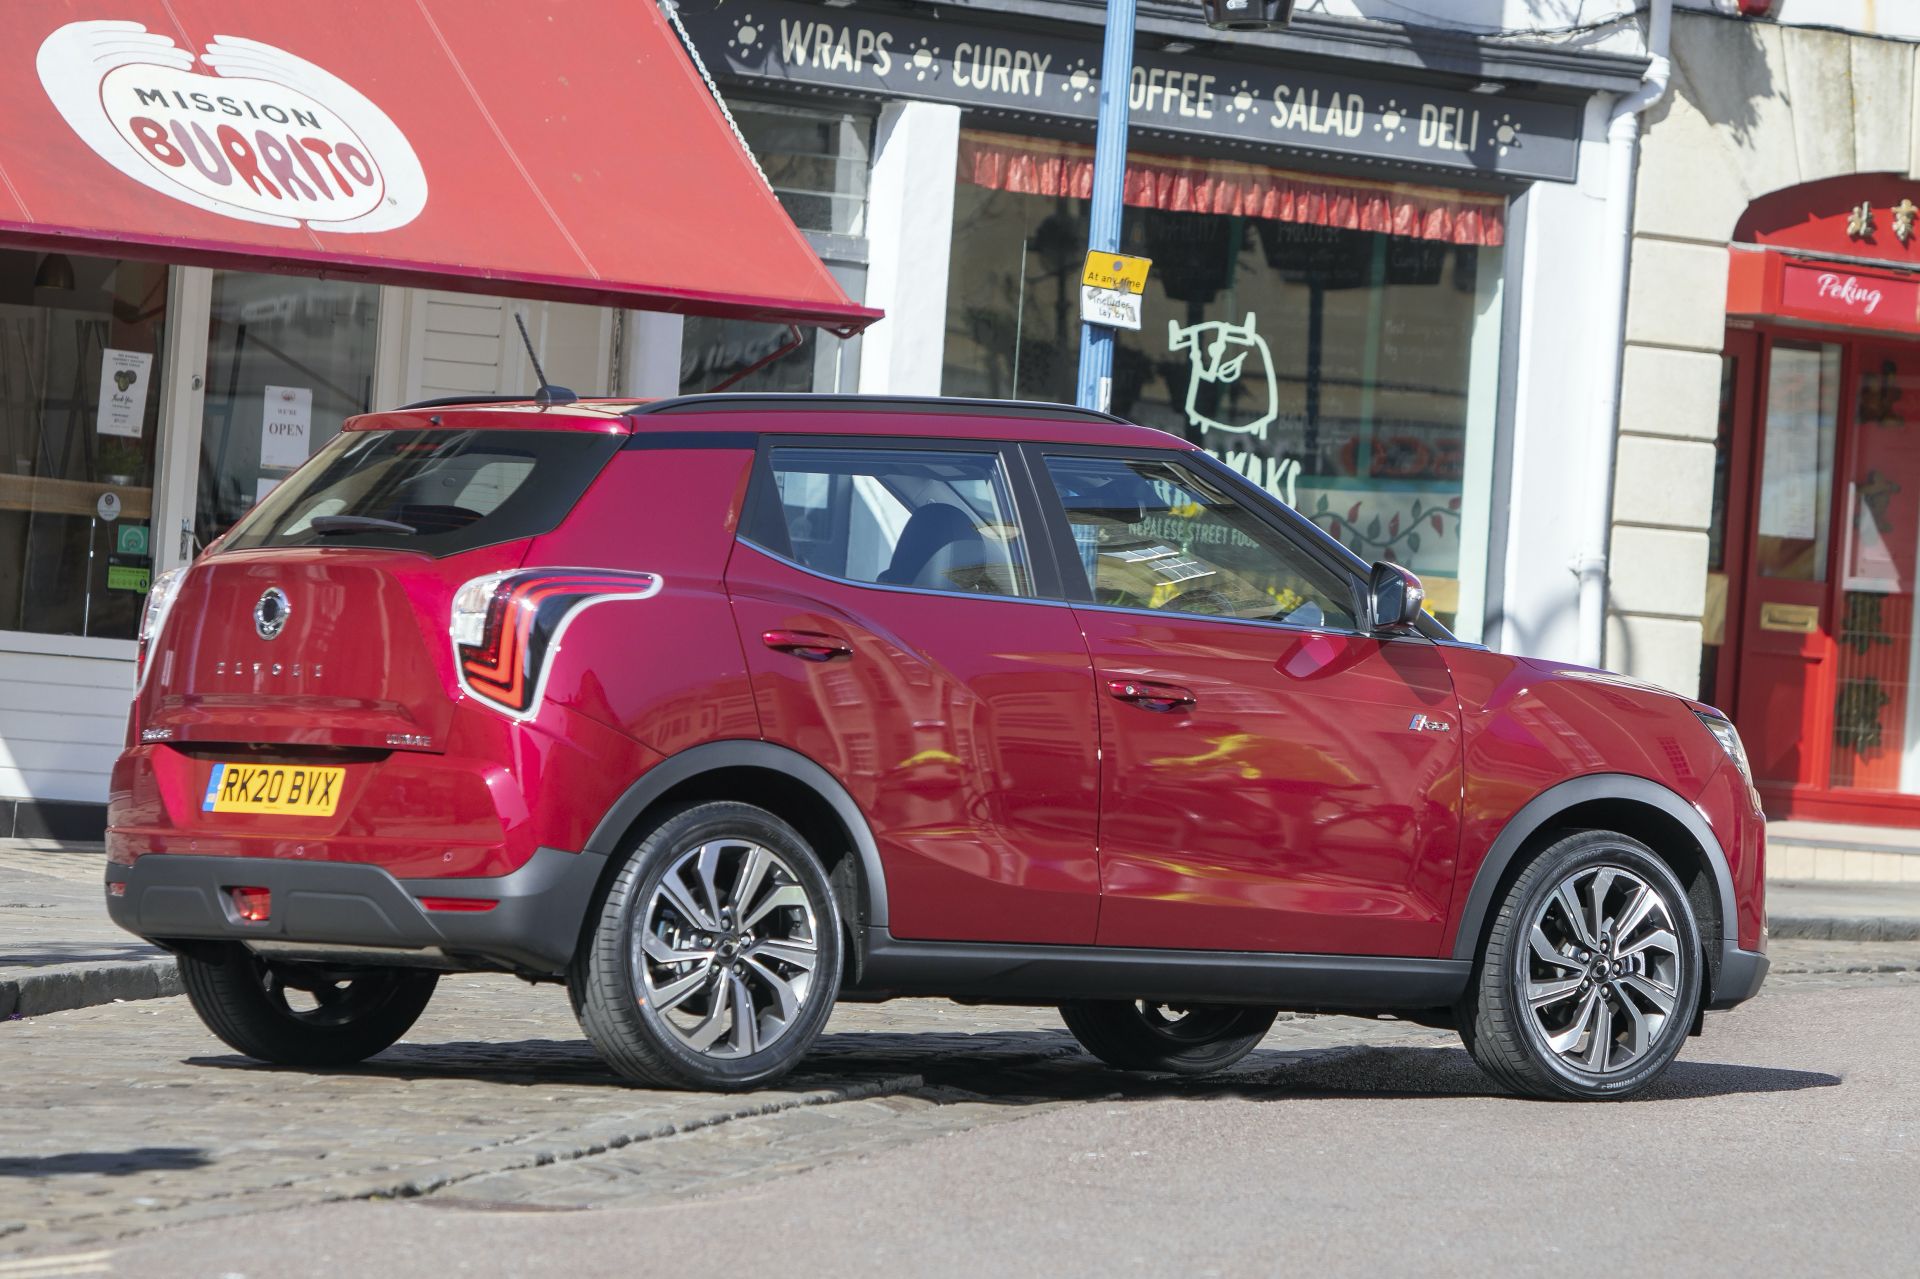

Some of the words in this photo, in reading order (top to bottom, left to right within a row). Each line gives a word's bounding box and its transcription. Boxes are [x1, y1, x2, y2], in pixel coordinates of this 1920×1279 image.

[780, 18, 894, 77] WRAPS
[952, 42, 1053, 98] CURRY
[1128, 65, 1217, 121] OFFEE
[1270, 84, 1365, 138] SALAD
[1418, 103, 1480, 153] DELI
[133, 87, 321, 130] MISSION
[129, 115, 376, 203] BURRITO
[1088, 272, 1098, 281] At
[1102, 276, 1118, 287] any
[1818, 273, 1882, 315] Peking
[268, 422, 305, 437] OPEN
[1128, 515, 1185, 542] NEPALESE
[1188, 521, 1228, 545] STREET
[1231, 527, 1259, 549] FOO
[221, 768, 285, 803] RK20
[287, 771, 338, 805] BVX
